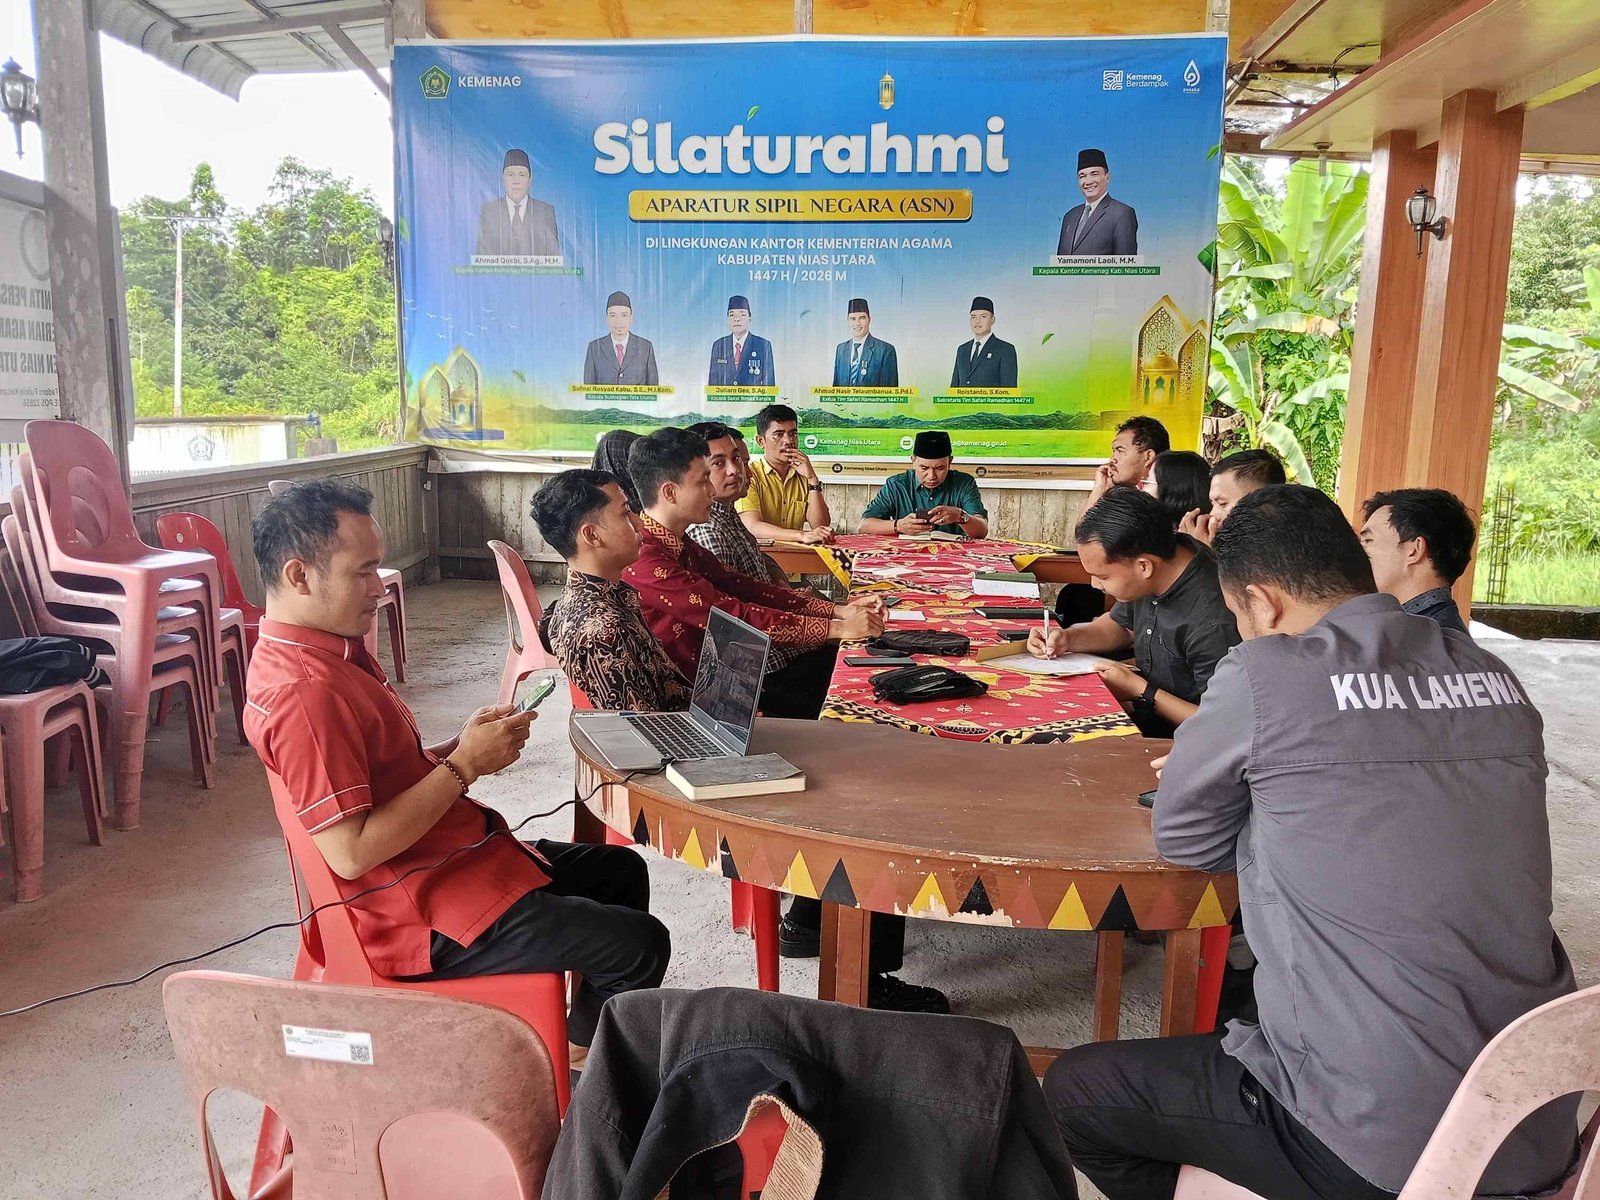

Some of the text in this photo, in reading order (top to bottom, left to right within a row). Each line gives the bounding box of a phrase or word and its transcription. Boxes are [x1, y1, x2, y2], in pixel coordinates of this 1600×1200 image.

[458, 76, 521, 88] KEMENAG
[1126, 73, 1162, 81] Kemenag
[593, 116, 1009, 174] Silaturahmi
[646, 197, 954, 215] APARATUR SIPIL NEGARA (ASN)
[646, 238, 952, 249] DI LINGKUNGAN KANTOR KEMENTERIAN AGAMA
[718, 254, 876, 265] KABUPATEN NIAS UTARA
[748, 268, 847, 283] 1447 H / 2026 M
[1330, 673, 1408, 711] KUA
